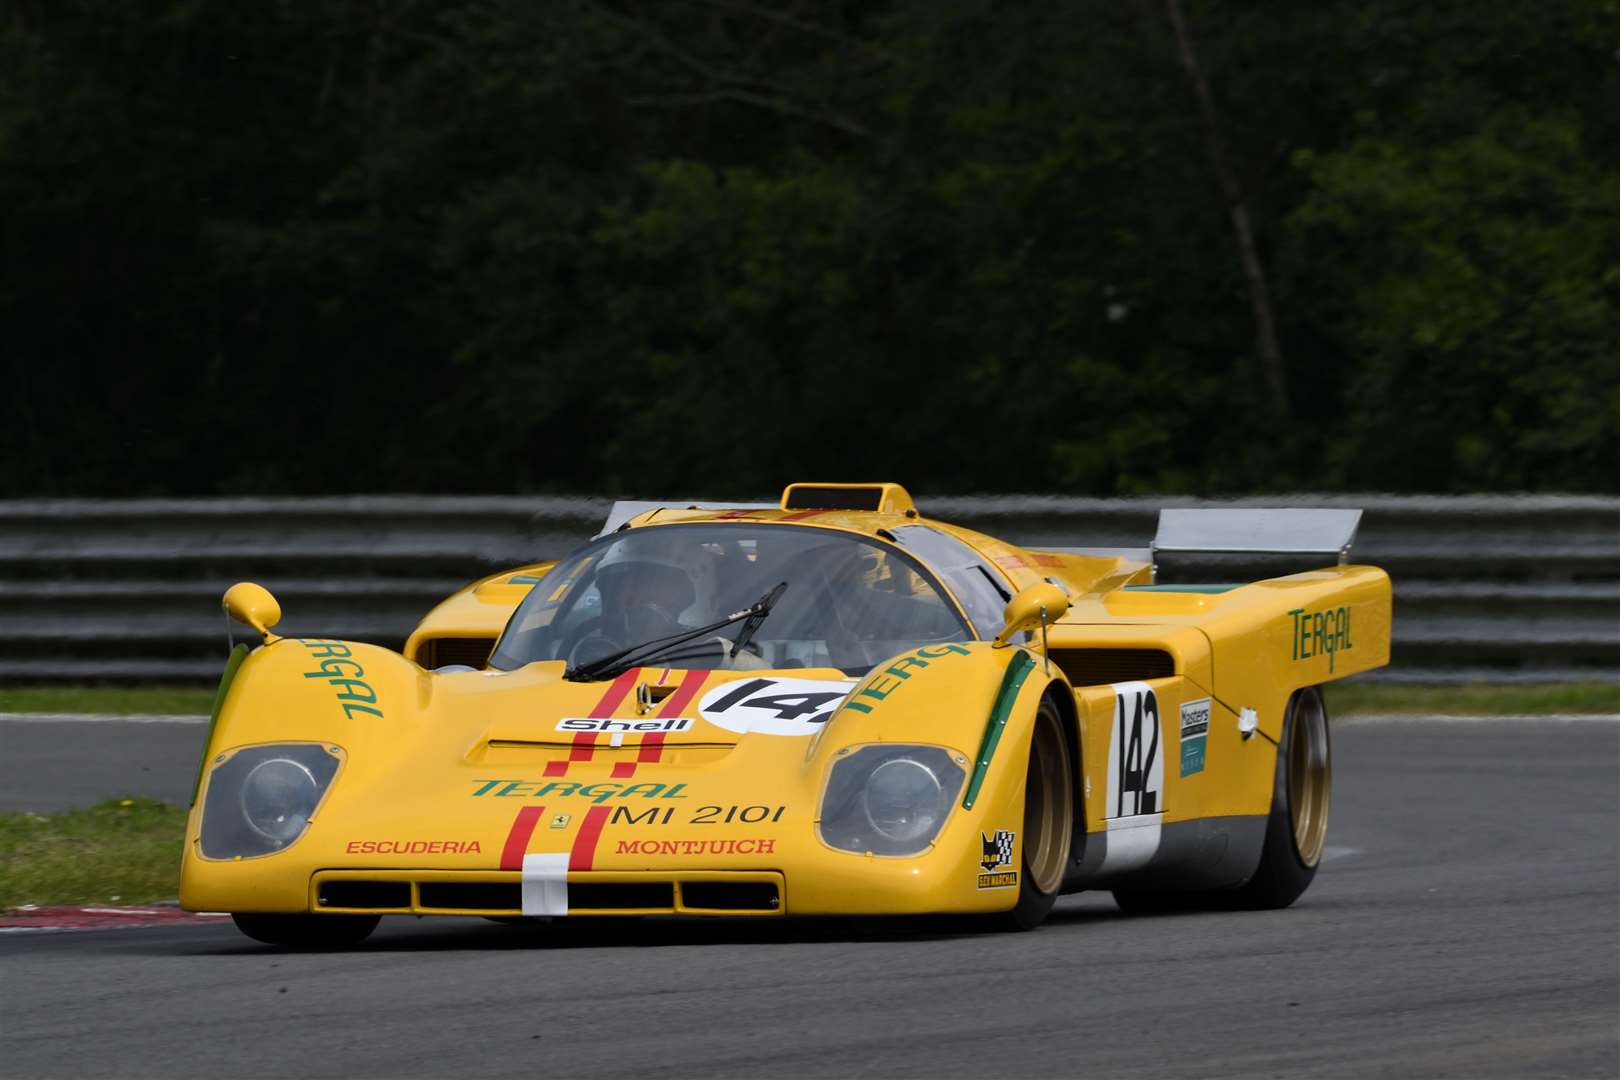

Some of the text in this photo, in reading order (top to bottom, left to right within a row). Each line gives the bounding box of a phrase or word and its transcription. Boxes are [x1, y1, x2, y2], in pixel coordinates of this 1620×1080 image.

[1287, 606, 1353, 674] TERGAL
[843, 641, 972, 715] TERG
[562, 719, 690, 731] Shell
[1181, 707, 1209, 726] Masters
[1116, 689, 1159, 818] 142
[472, 779, 688, 804] TERGAL
[611, 805, 786, 825] MI 2101
[347, 841, 481, 854] ESCUDERIA
[615, 839, 776, 855] MONTJUICH
